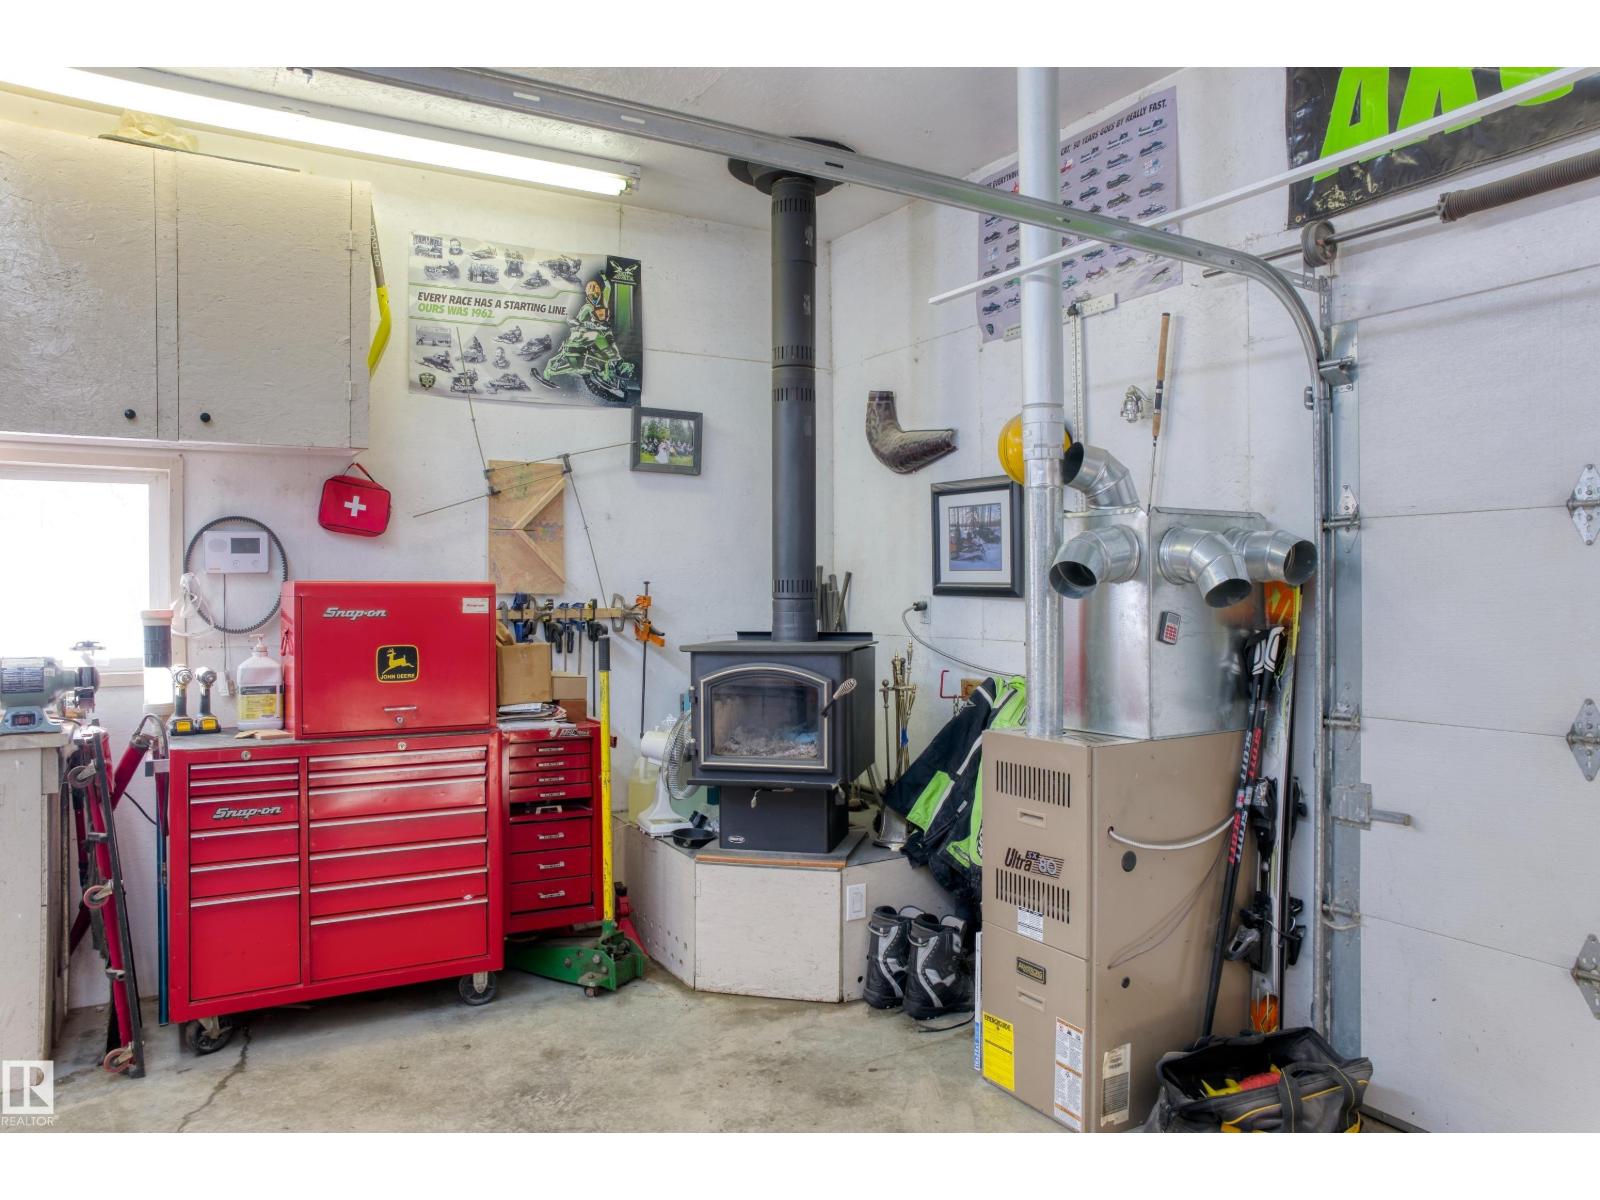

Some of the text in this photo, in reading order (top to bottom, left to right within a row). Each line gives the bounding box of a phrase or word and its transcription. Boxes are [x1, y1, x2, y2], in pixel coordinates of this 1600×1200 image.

[1082, 130, 1099, 145] YEARS
[1100, 123, 1115, 136] GOES
[1116, 117, 1124, 129] BY
[1125, 105, 1147, 123] REALLY
[1149, 99, 1168, 113] FAST.
[417, 291, 568, 316] EVERY RACE HAS A STARTING LINE.
[417, 303, 496, 319] OURS WAS 1962.
[323, 607, 388, 621] Snap-on
[1240, 730, 1253, 783] SCOTT
[1248, 727, 1262, 778] SCOTT
[212, 806, 283, 821] Snap-on
[1228, 812, 1242, 865] SCOTT
[1235, 810, 1248, 863] SCOTT
[1004, 847, 1057, 875] Ultra 80
[1026, 852, 1038, 860] SX
